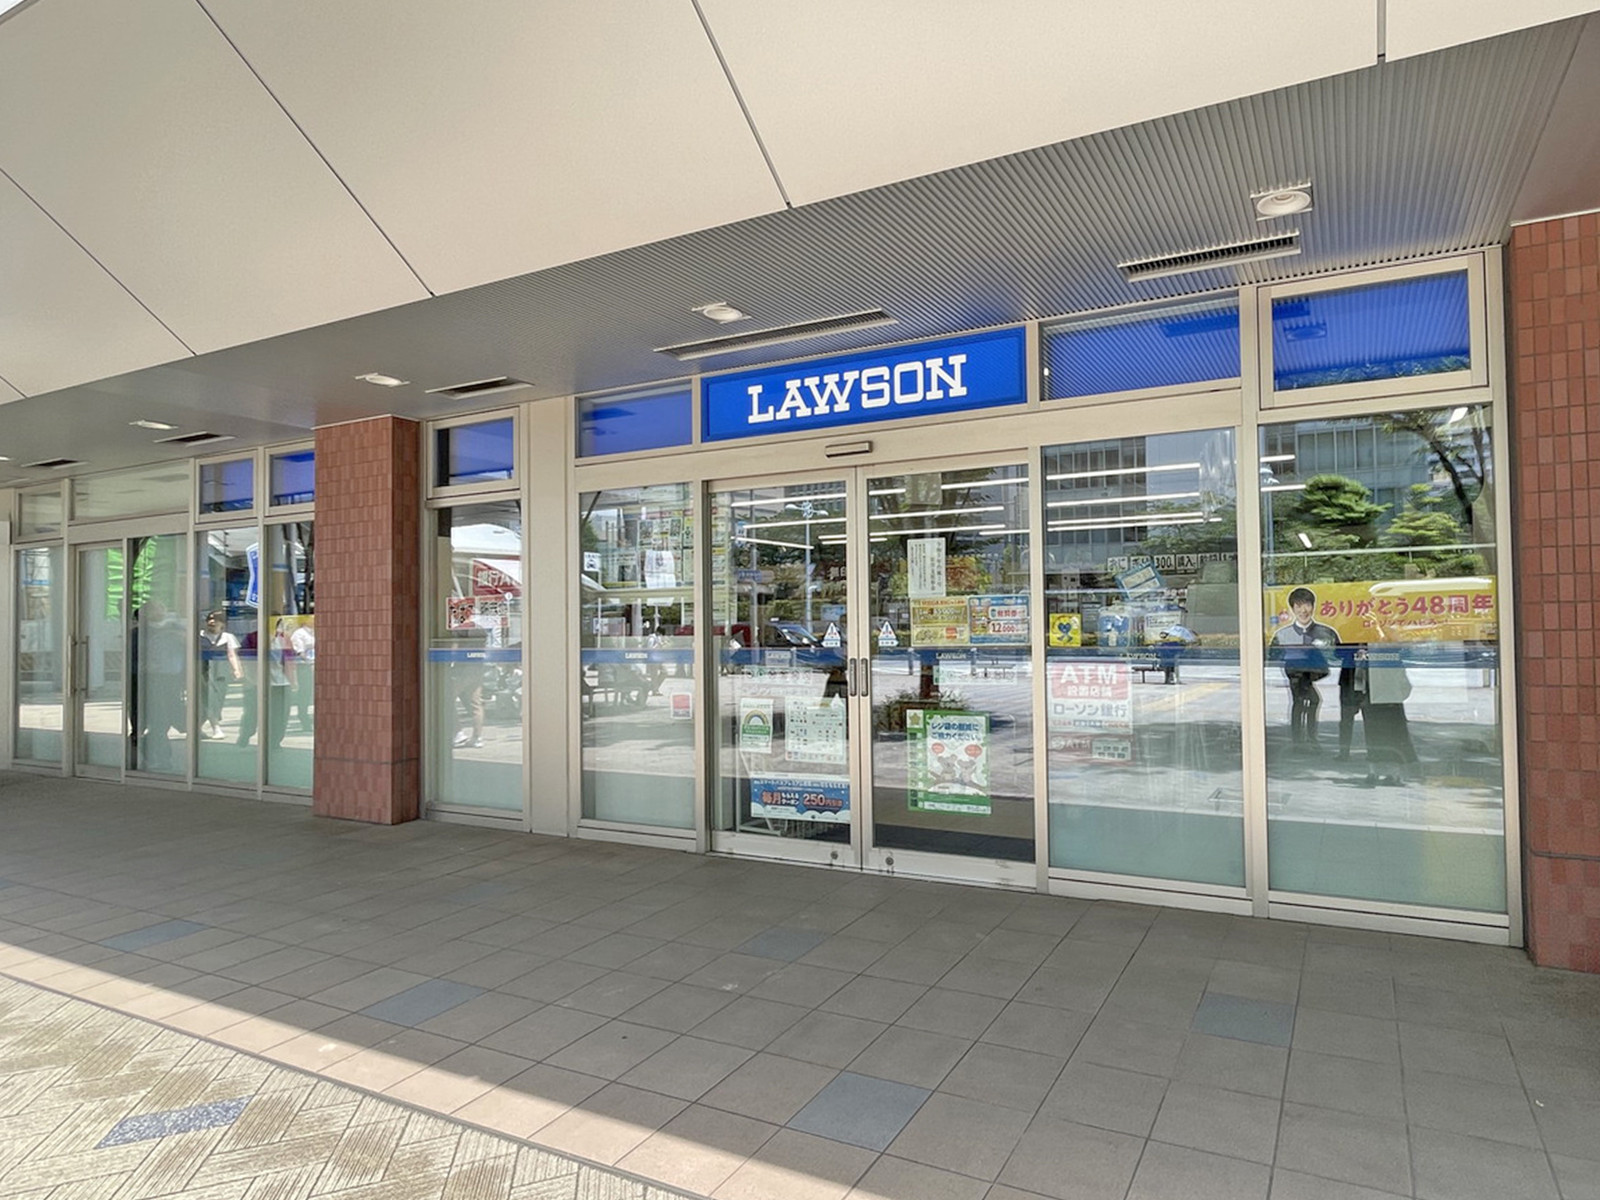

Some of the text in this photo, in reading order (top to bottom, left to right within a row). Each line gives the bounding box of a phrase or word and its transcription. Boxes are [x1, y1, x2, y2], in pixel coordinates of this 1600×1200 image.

[748, 354, 967, 423] LAWSON
[1320, 594, 1494, 616] ありがとう48周年
[1060, 665, 1117, 684] ATM
[1054, 703, 1127, 717] ローソン銀行
